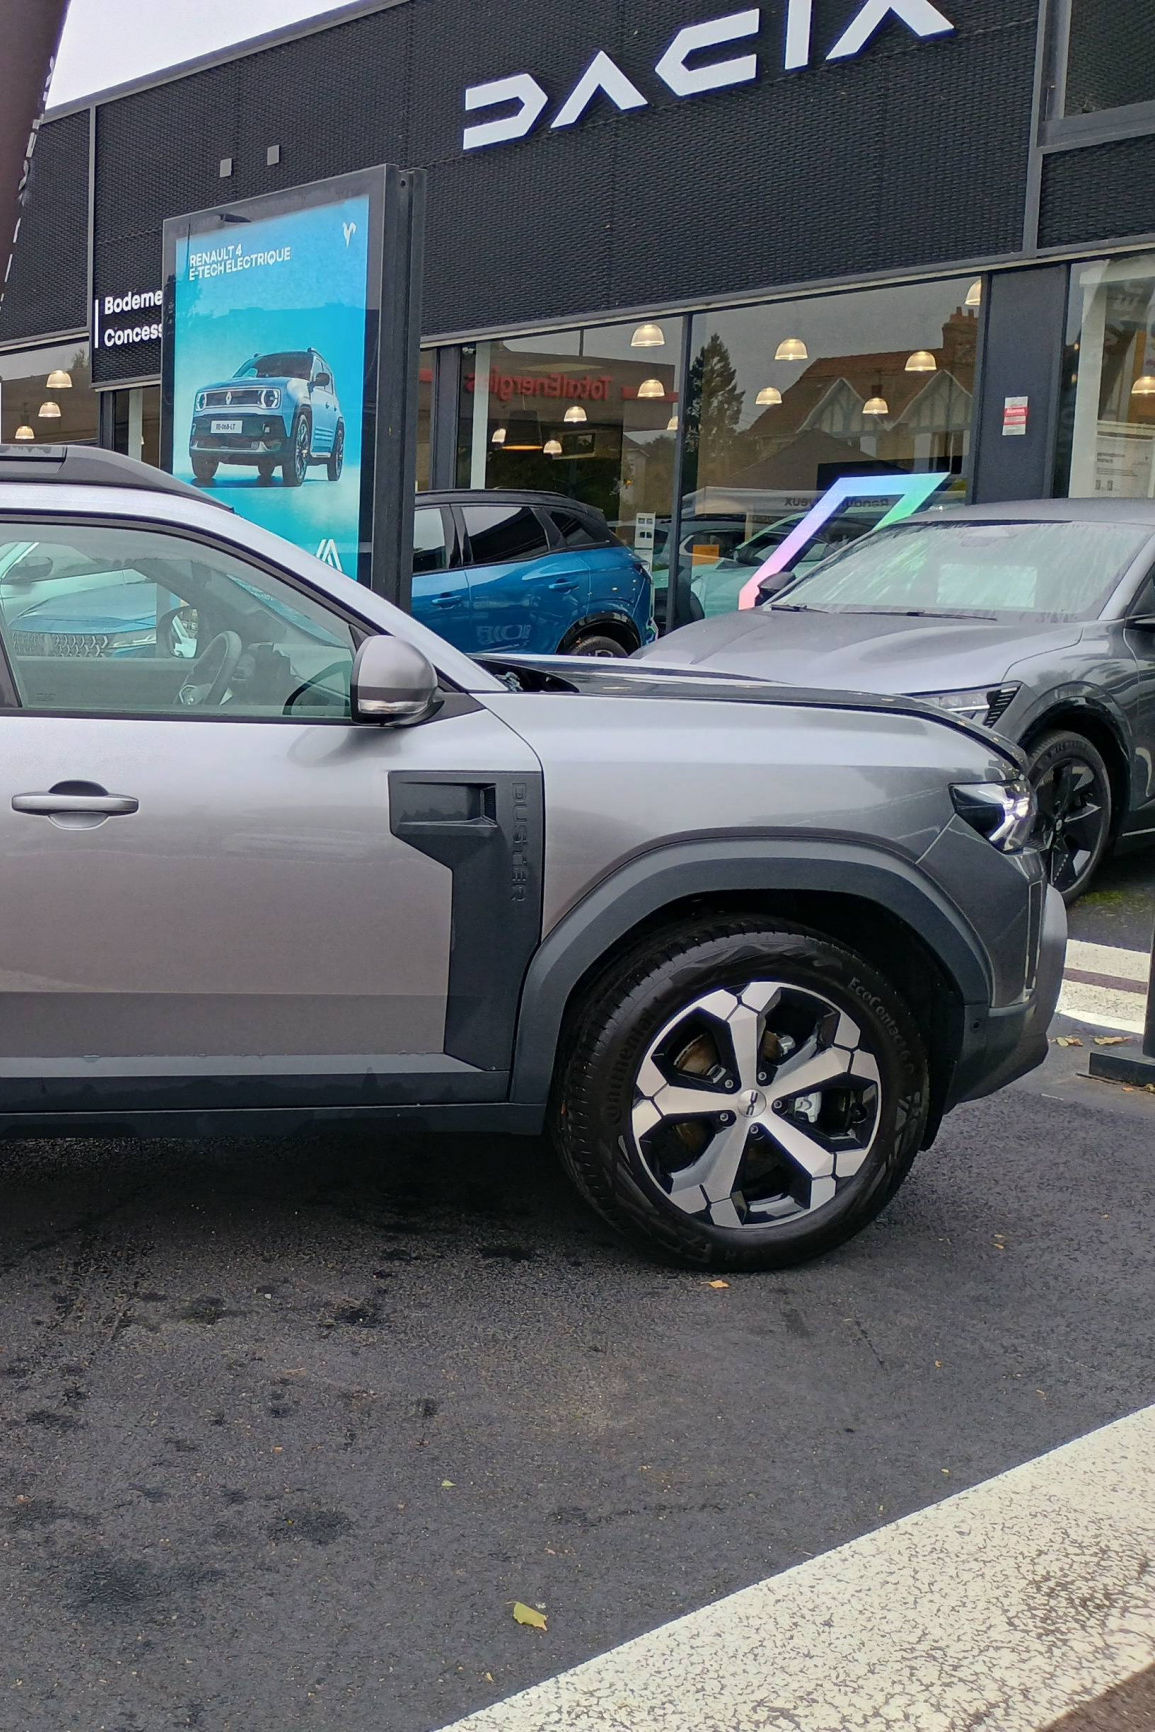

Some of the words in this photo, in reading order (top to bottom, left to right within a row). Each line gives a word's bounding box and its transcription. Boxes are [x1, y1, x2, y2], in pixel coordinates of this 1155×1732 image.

[463, 0, 955, 150] DACIA
[189, 261, 225, 281] E-TECH
[190, 245, 235, 267] RENAULT
[235, 243, 242, 256] 4
[512, 783, 527, 901] DUSTER
